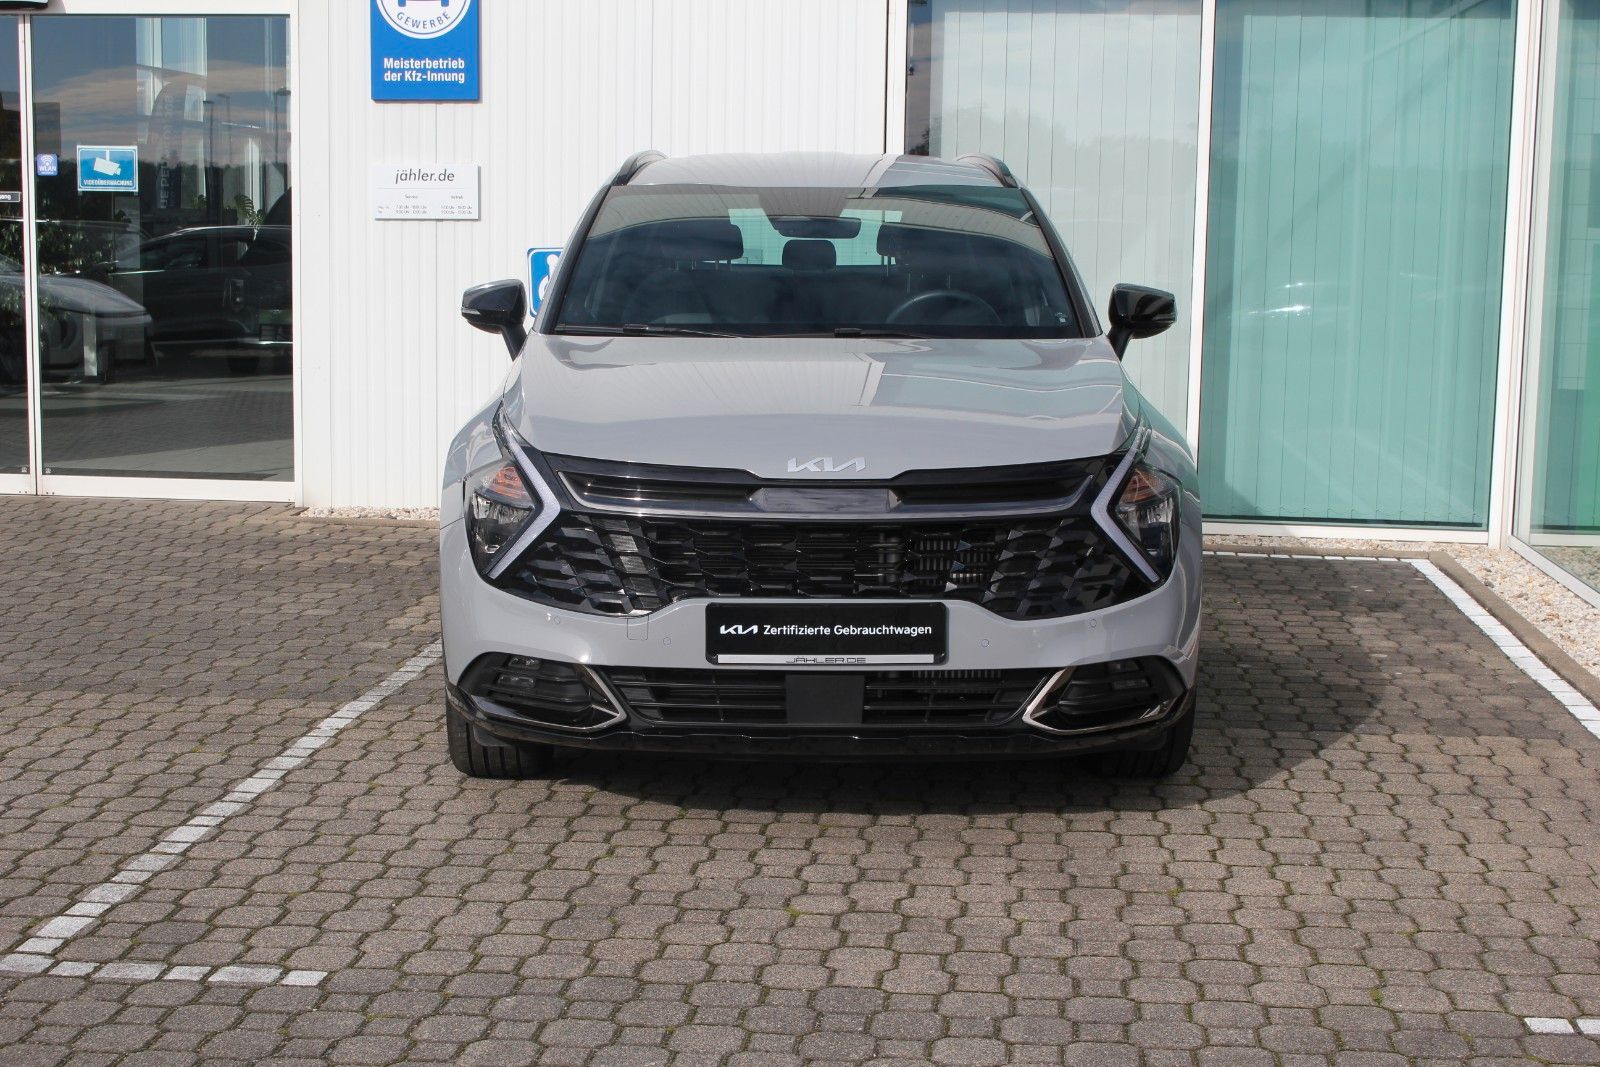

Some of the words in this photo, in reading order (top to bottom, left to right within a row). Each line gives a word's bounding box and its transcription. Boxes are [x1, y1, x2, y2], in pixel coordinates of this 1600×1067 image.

[396, 11, 451, 30] GEWERBE
[383, 57, 465, 69] Meisterbetrieb
[384, 70, 402, 82] der
[404, 70, 465, 84] Kfz-Innung
[395, 168, 455, 185] jähler.de
[787, 456, 866, 473] KIA
[719, 624, 759, 635] KIA
[763, 624, 831, 636] Zertifizierte
[833, 624, 932, 637] Gebrauchtwagen
